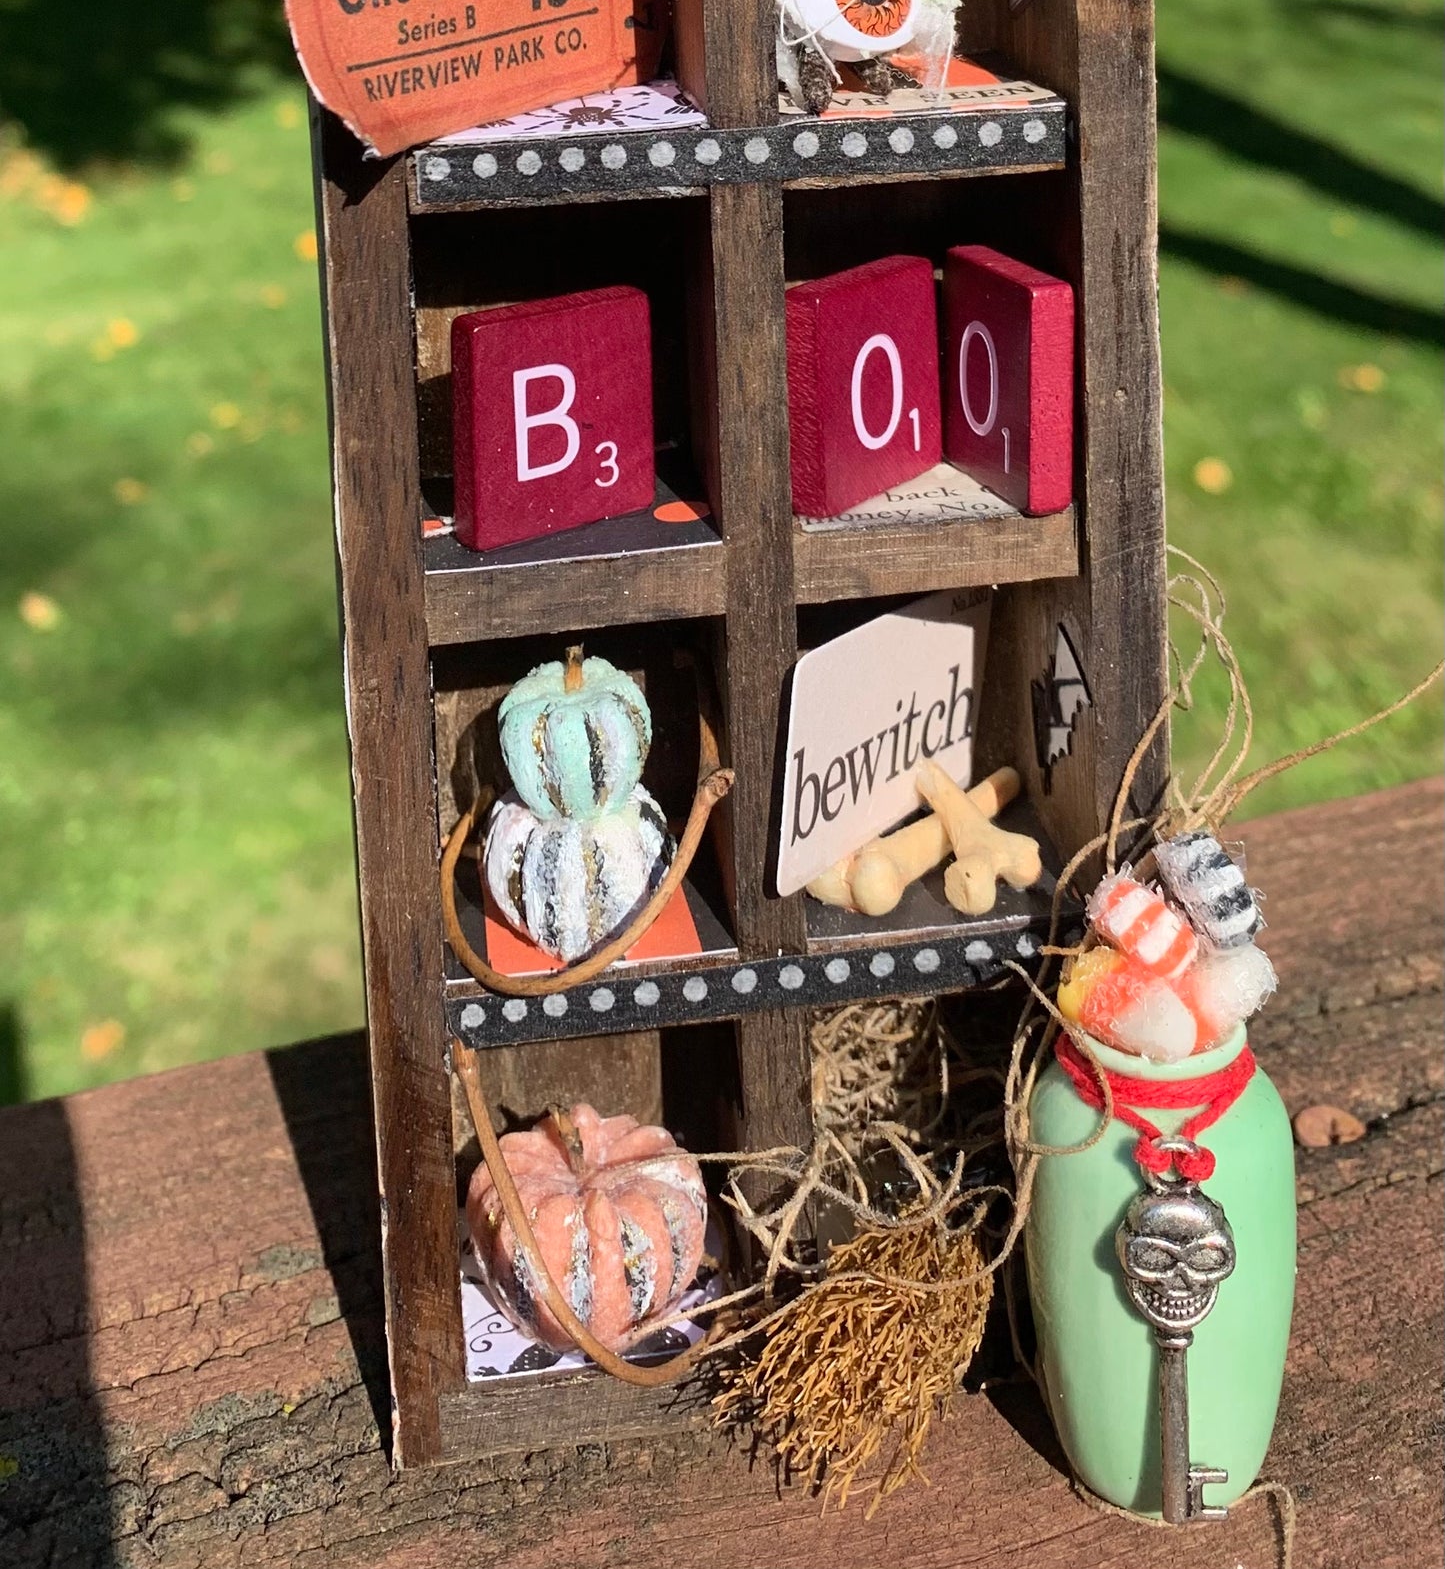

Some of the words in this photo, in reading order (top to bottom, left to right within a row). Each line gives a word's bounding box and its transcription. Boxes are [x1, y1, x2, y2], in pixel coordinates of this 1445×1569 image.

[397, 14, 457, 45] Series
[465, 5, 477, 29] B
[361, 49, 483, 103] RIVERVIEW
[495, 35, 545, 72] PARK
[555, 27, 588, 56] CO.
[513, 364, 580, 482] B
[595, 441, 620, 487] 3
[908, 407, 921, 452] 1
[885, 487, 961, 503] back
[933, 500, 998, 515] No.
[790, 663, 975, 847] bewitch
